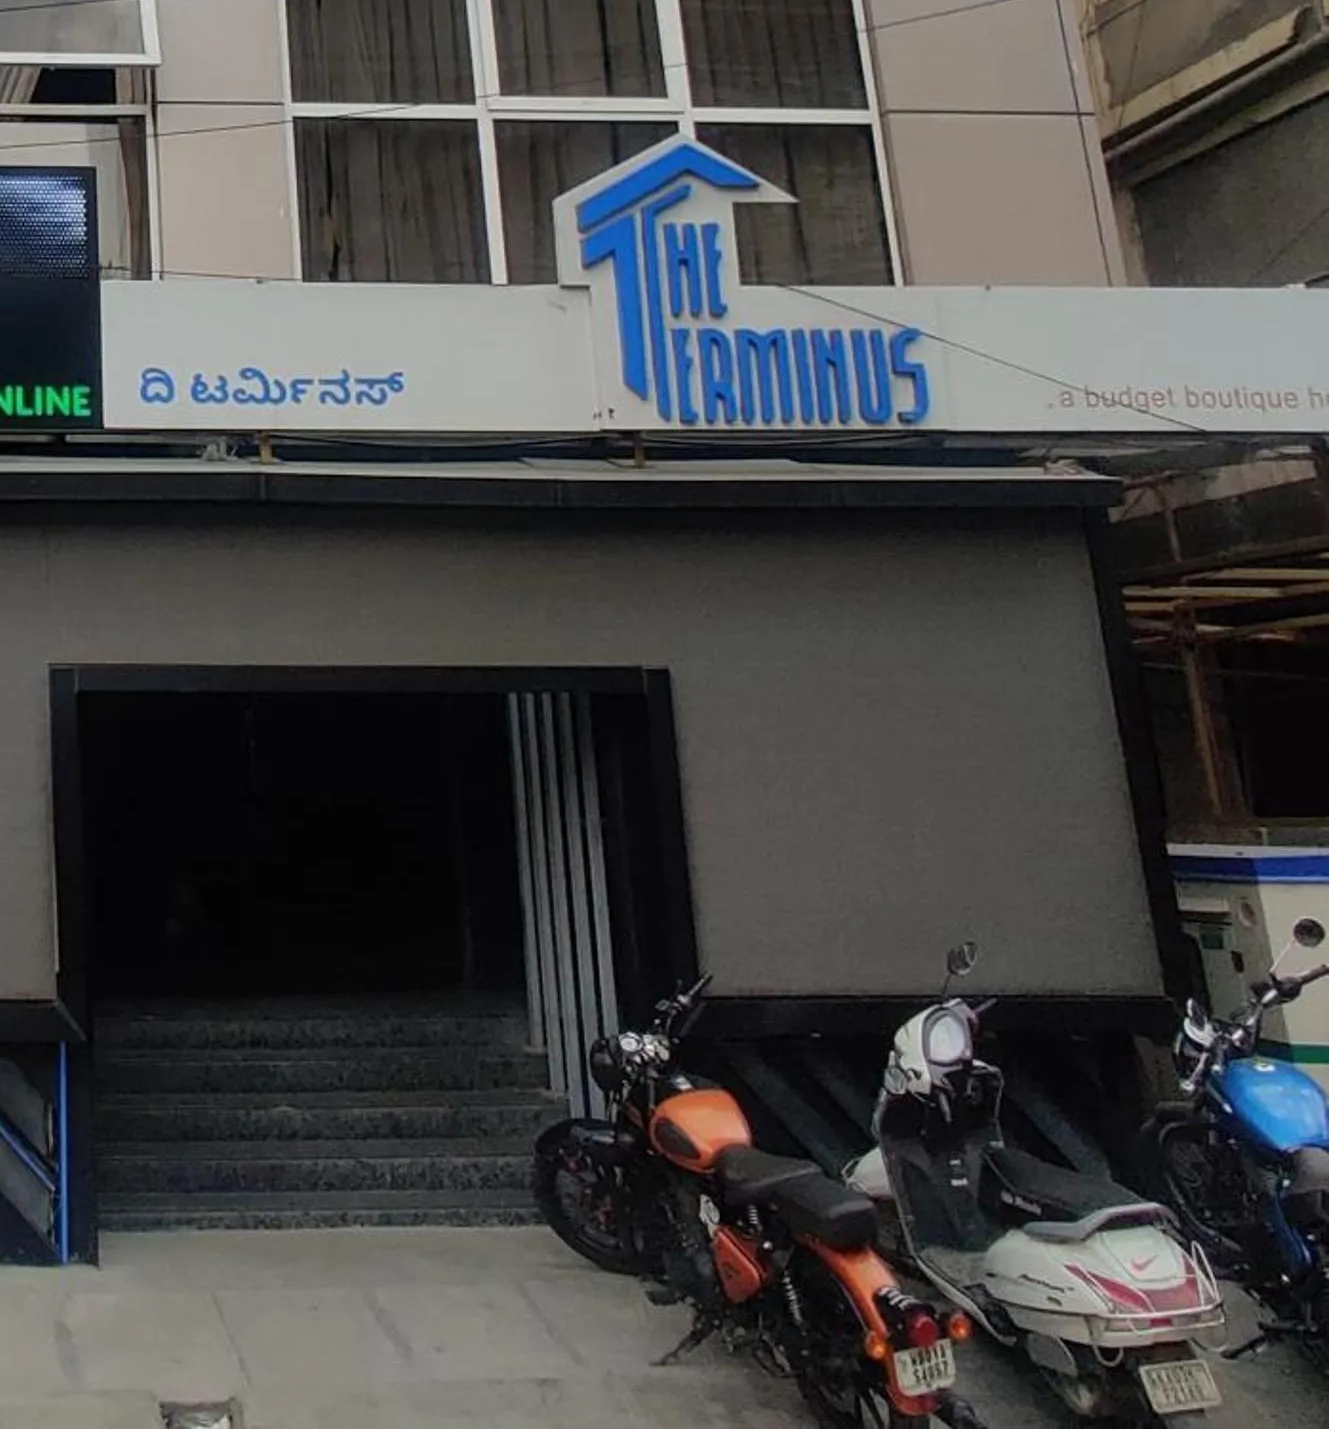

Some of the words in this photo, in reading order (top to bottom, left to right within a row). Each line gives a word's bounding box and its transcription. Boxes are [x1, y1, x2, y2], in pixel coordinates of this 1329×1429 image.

[139, 367, 176, 405] ದಿ
[189, 367, 405, 406] ಟರ್ಮಿನಸ್
[1084, 384, 1175, 413] budget
[1185, 384, 1299, 413] boutique
